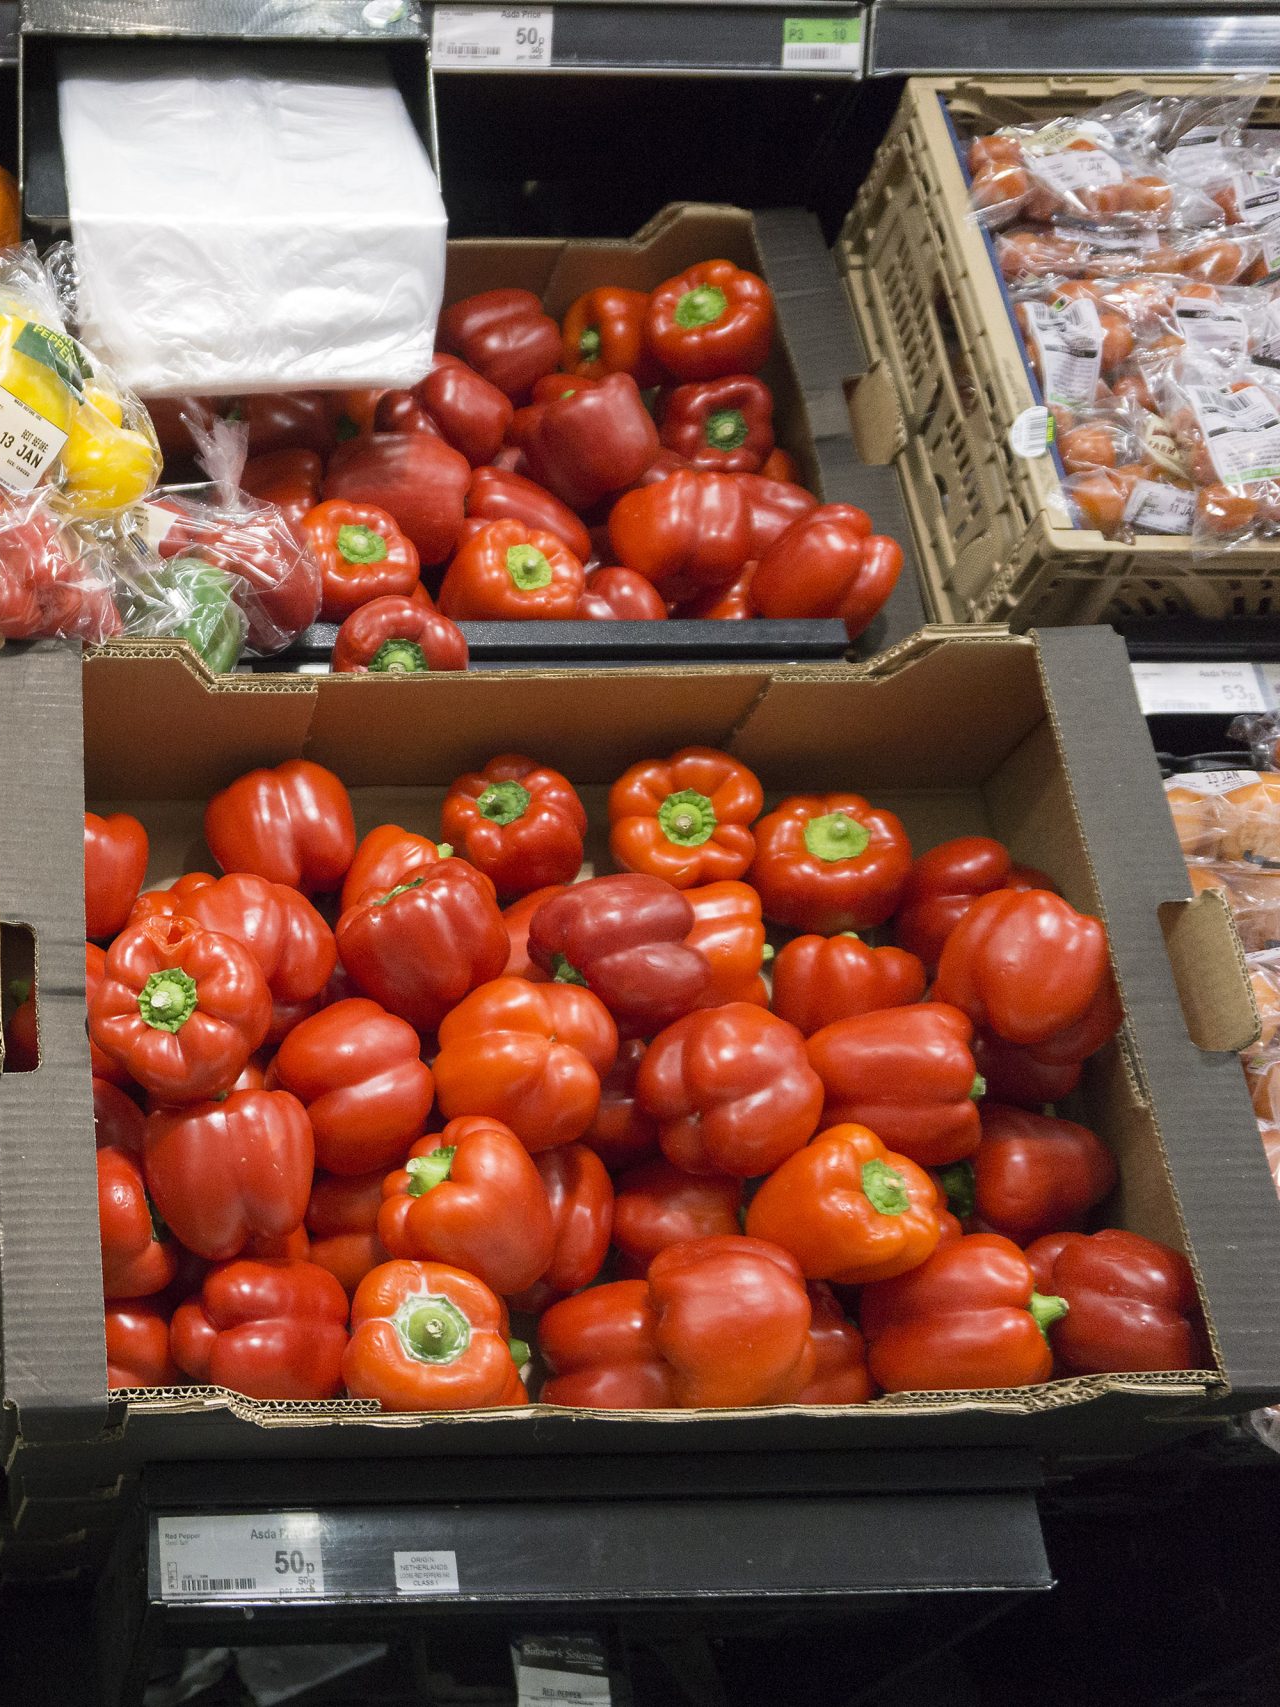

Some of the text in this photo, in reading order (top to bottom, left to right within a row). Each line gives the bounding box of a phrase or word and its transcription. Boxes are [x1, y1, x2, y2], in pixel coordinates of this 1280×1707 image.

[501, 10, 541, 18] Asda Price
[516, 27, 545, 46] 50p
[531, 46, 544, 55] 50p
[20, 428, 49, 454] BEST BEFORE:
[0, 431, 15, 449] 13
[16, 444, 44, 468] JAN
[1169, 503, 1179, 513] 11
[1222, 685, 1256, 703] 53p
[1221, 770, 1240, 781] JAN
[250, 1529, 277, 1540] Asda
[275, 1550, 315, 1577] 50p
[298, 1576, 316, 1587] 50p
